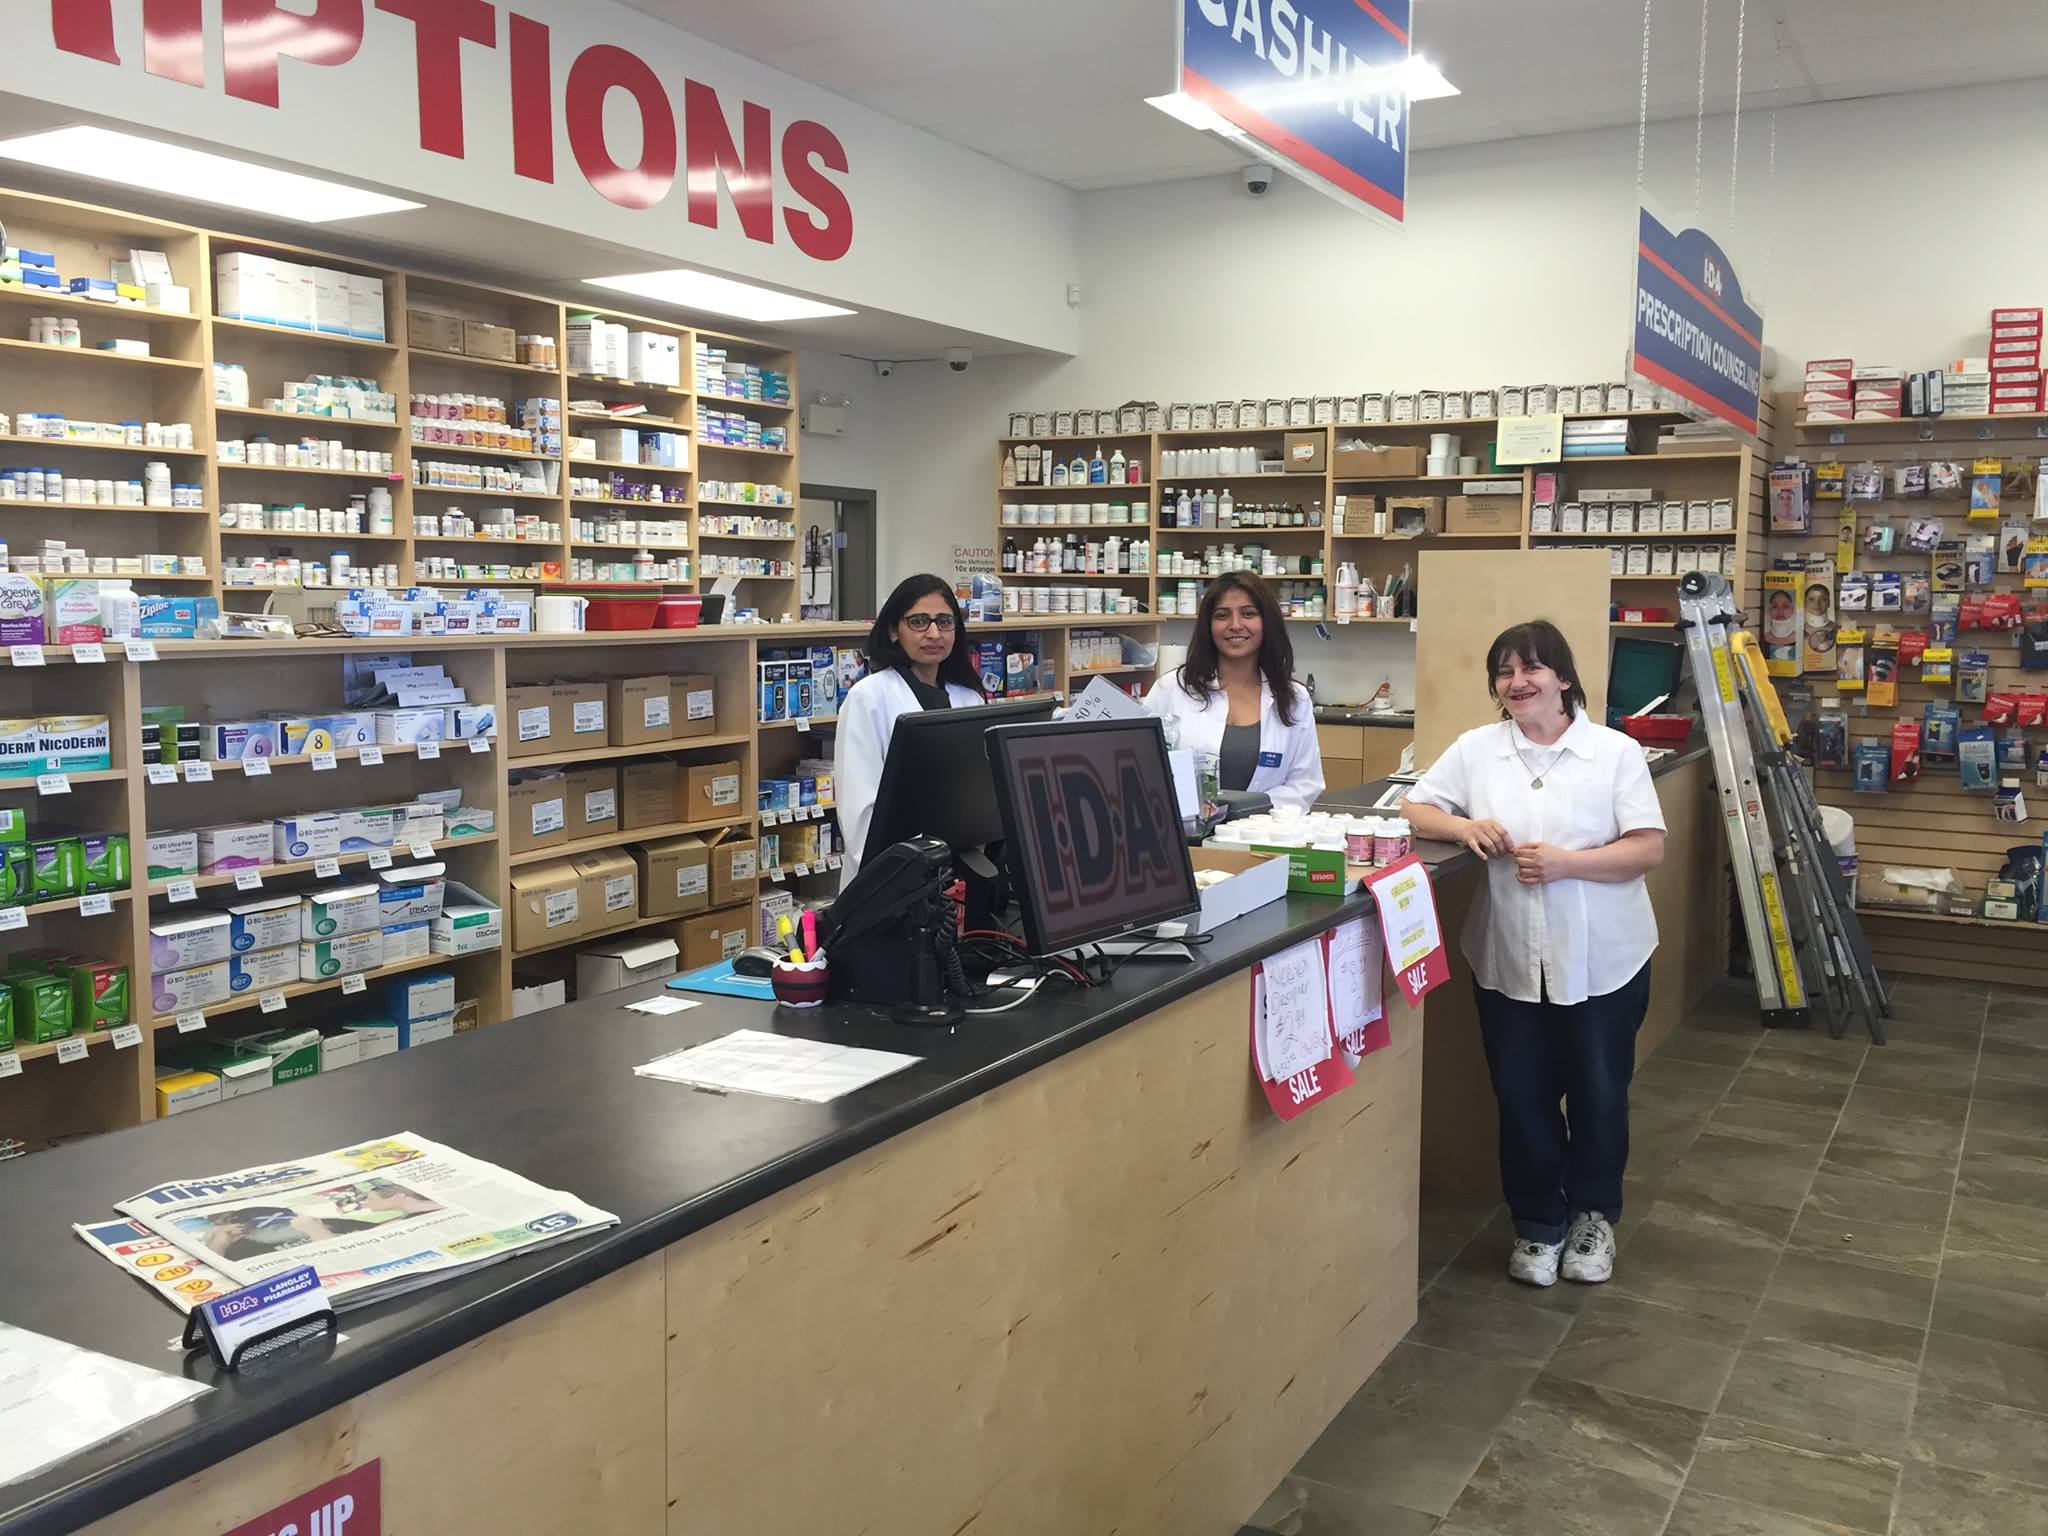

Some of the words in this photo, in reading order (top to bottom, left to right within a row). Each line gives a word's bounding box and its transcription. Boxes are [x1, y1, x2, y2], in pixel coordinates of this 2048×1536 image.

[1638, 287, 1712, 366] PRESCRIPTION
[1712, 341, 1759, 396] COUNSELING
[969, 566, 995, 574] stronge
[140, 600, 169, 619] Ziploc
[314, 734, 323, 749] 8
[358, 727, 365, 742] 6
[0, 742, 35, 755] DERM
[254, 740, 263, 755] 6
[1406, 963, 1428, 995] SALE
[1346, 1025, 1366, 1056] SALE
[1288, 1066, 1322, 1105] SALE
[143, 1167, 319, 1205] Times
[342, 1234, 382, 1252] bring
[384, 1229, 405, 1241] big
[406, 1211, 470, 1234] problems
[531, 1215, 560, 1234] 15
[263, 1279, 312, 1304] PHARMACY
[269, 1271, 310, 1293] LANGLEY
